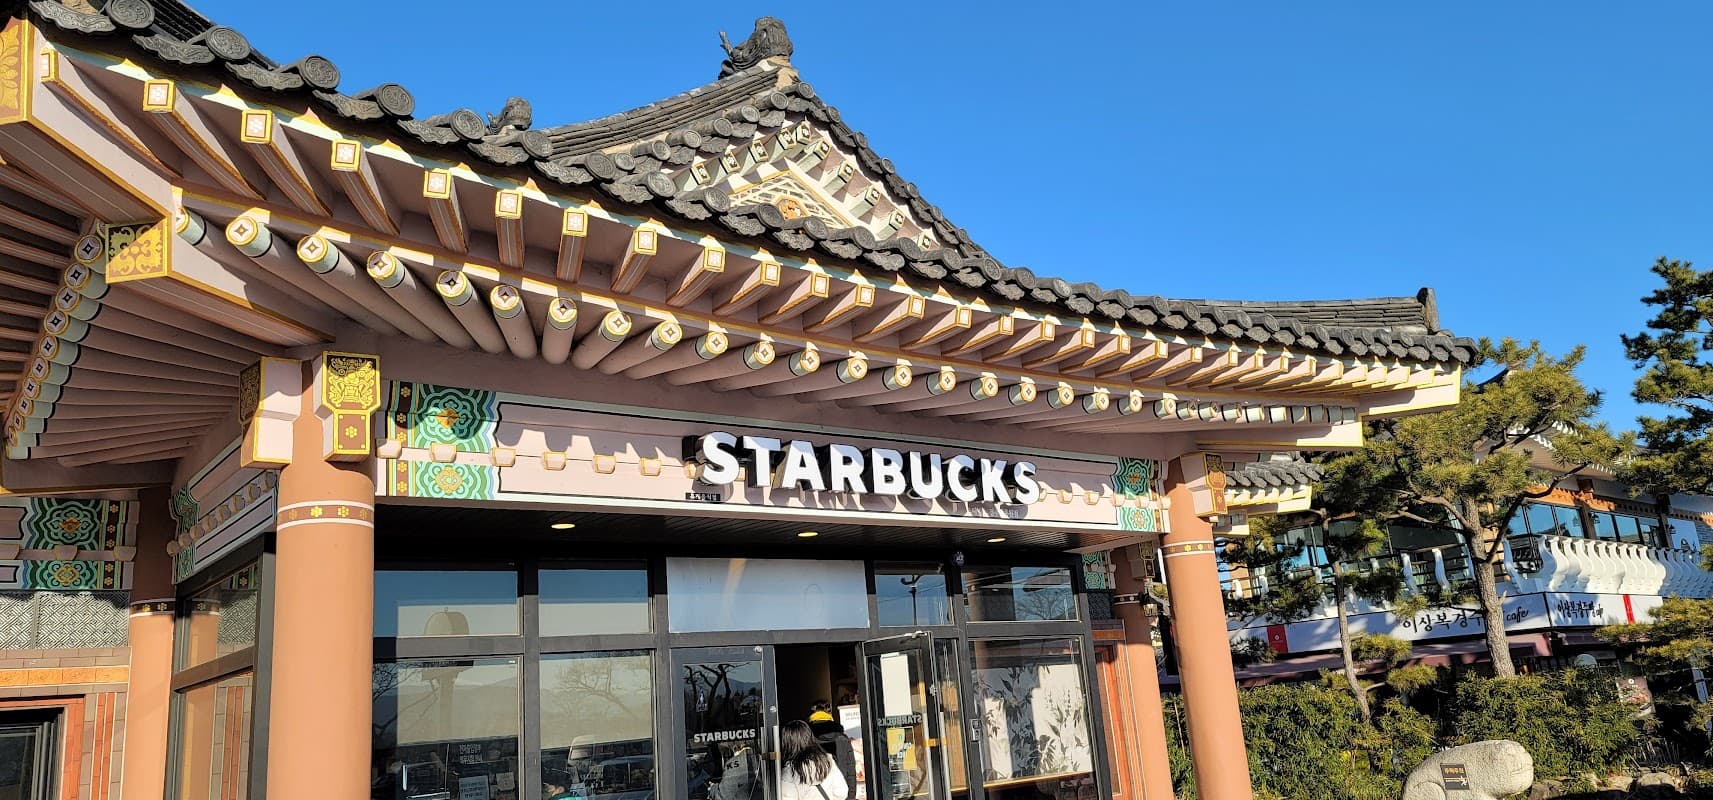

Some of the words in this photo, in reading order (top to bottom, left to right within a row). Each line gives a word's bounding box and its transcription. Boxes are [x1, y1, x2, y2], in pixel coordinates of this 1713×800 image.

[699, 431, 1036, 505] STARBUCKS
[1402, 608, 1504, 633] 이상복경주
[1506, 605, 1529, 623] cafe
[693, 728, 756, 743] STARBUCKS
